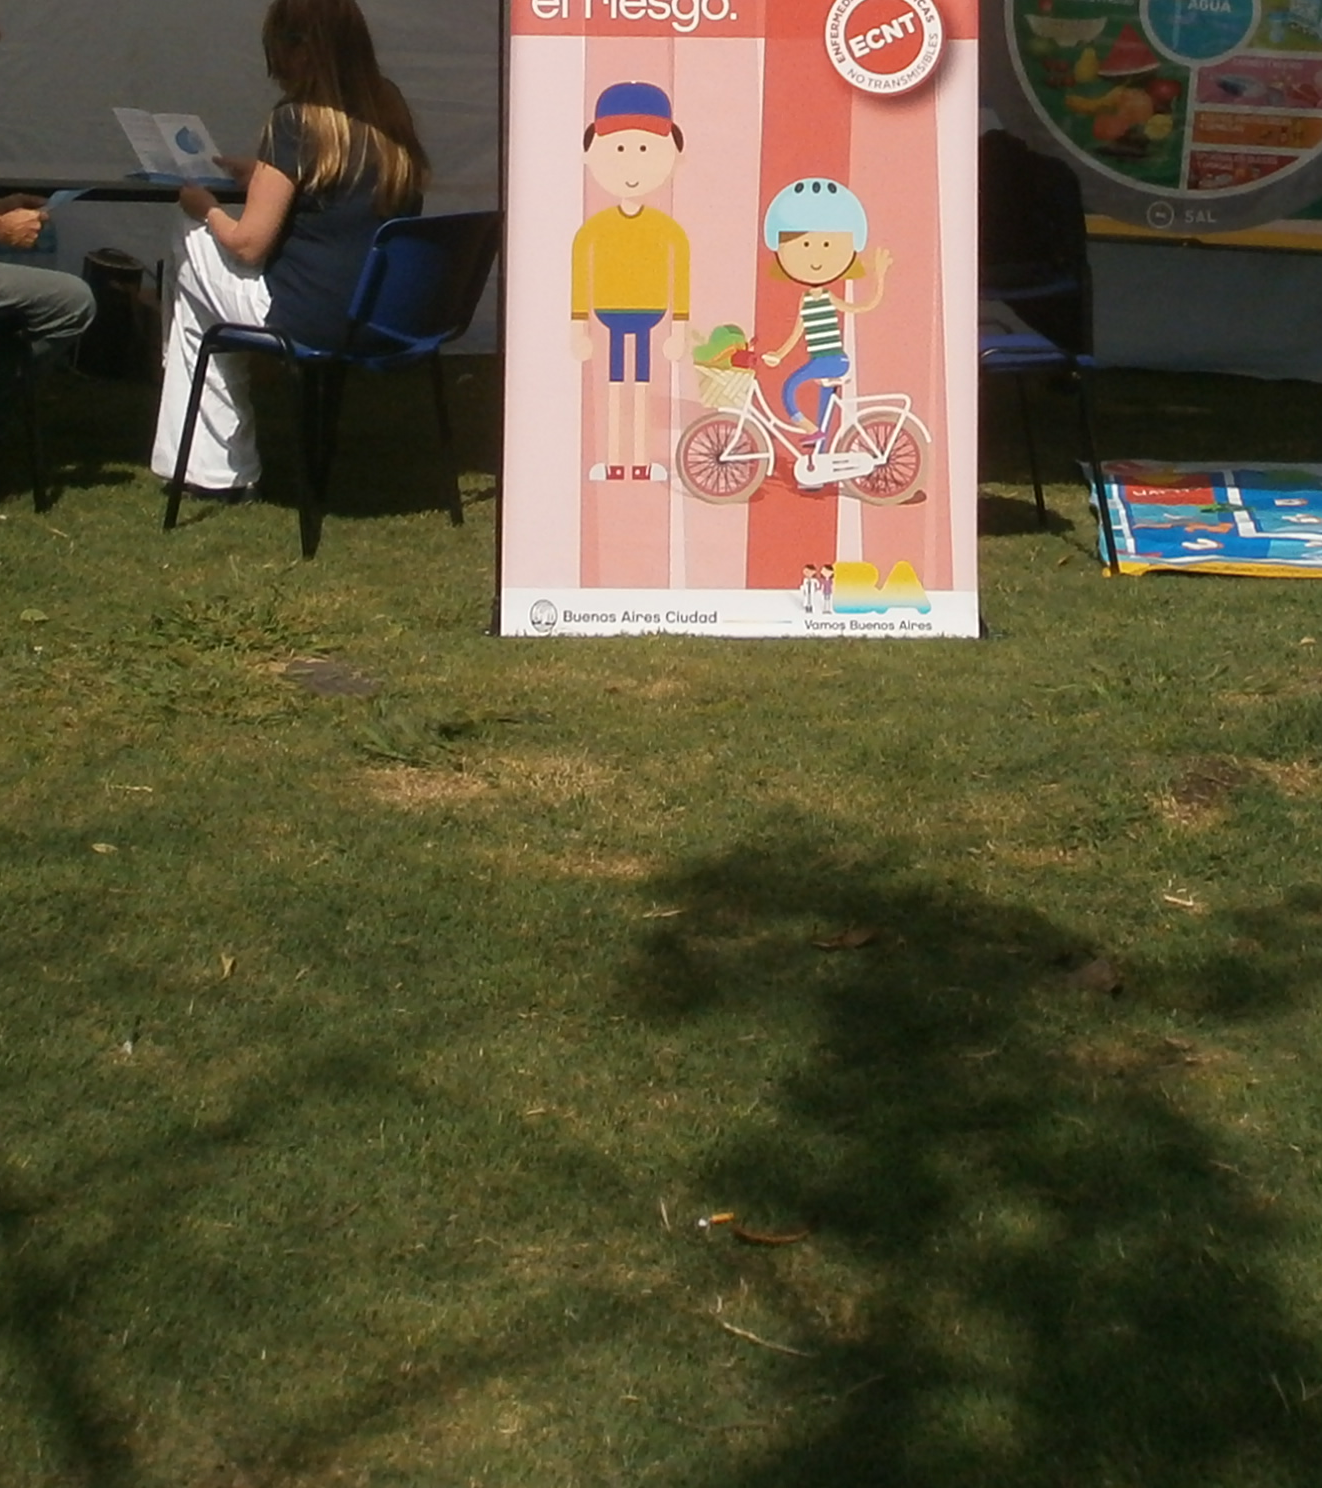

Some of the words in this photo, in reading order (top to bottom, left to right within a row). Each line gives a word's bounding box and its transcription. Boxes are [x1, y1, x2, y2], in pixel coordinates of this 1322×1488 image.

[848, 12, 915, 58] ECNT
[847, 68, 865, 84] NO
[868, 32, 939, 89] TRANSMISIBLES
[1184, 211, 1217, 224] SAL
[562, 610, 615, 624] Buenos
[621, 610, 661, 624] Aires
[665, 610, 718, 624] Ciudad
[804, 619, 846, 631] Vamos
[849, 619, 894, 631] Buenos
[898, 619, 932, 631] Aires
